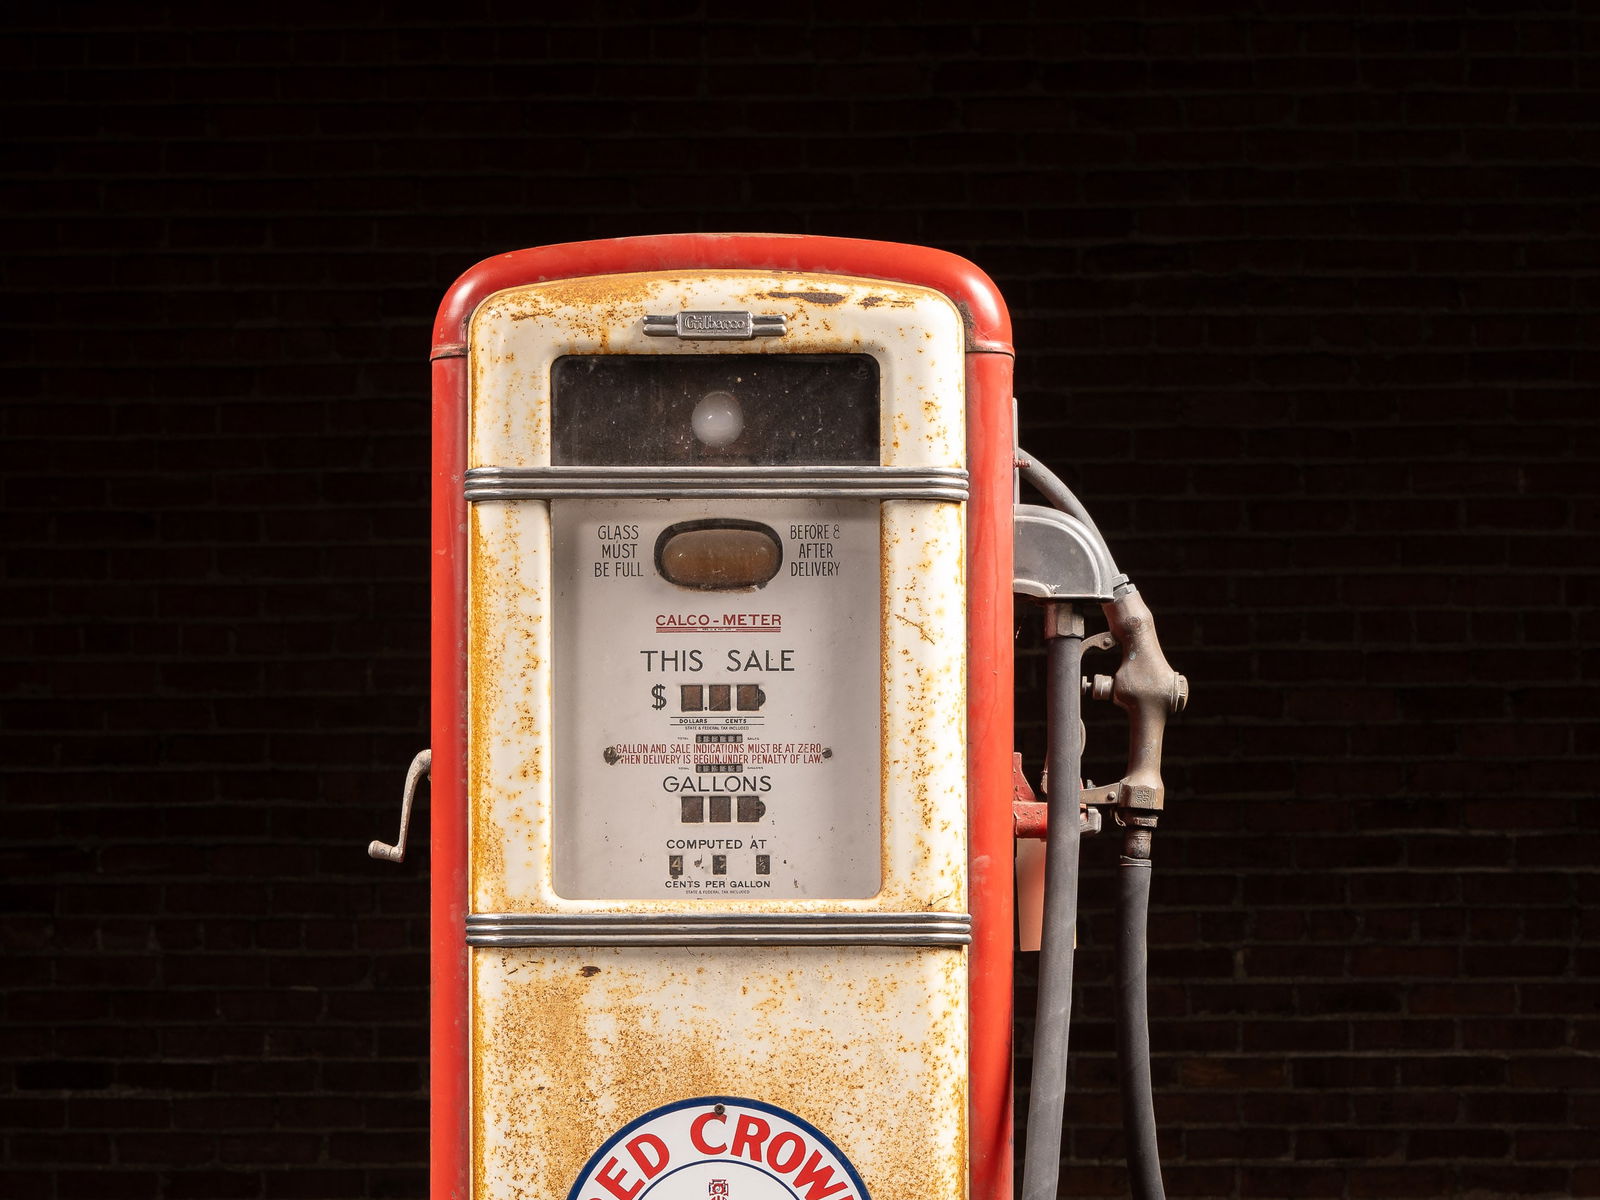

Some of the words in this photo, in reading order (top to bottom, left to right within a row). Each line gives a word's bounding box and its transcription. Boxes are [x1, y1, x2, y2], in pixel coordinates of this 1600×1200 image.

[684, 315, 745, 330] Gilbarco
[597, 524, 640, 540] GLASS
[790, 524, 830, 540] BEFORE
[601, 543, 638, 559] MUST
[798, 543, 834, 559] AFTER
[594, 562, 610, 578] BE
[615, 562, 644, 578] FULL
[790, 562, 841, 577] DELIVERY
[640, 650, 704, 672] THIS
[726, 650, 795, 672] SALE
[651, 683, 667, 711] $
[616, 743, 648, 754] GALLON
[650, 743, 667, 754] AND
[670, 743, 691, 754] SALE
[693, 743, 745, 754] INDICATIONS
[748, 743, 770, 754] MUST
[772, 743, 782, 754] BE
[785, 743, 795, 754] AT
[643, 754, 681, 764] DELIVERY
[683, 754, 691, 764] IS
[722, 754, 749, 764] UNDER
[752, 754, 787, 765] PENALTY
[790, 754, 801, 765] OF
[803, 754, 823, 765] LAW.
[662, 775, 772, 793] GALLONS
[666, 840, 743, 849] COMPUTED
[750, 840, 768, 849] AT
